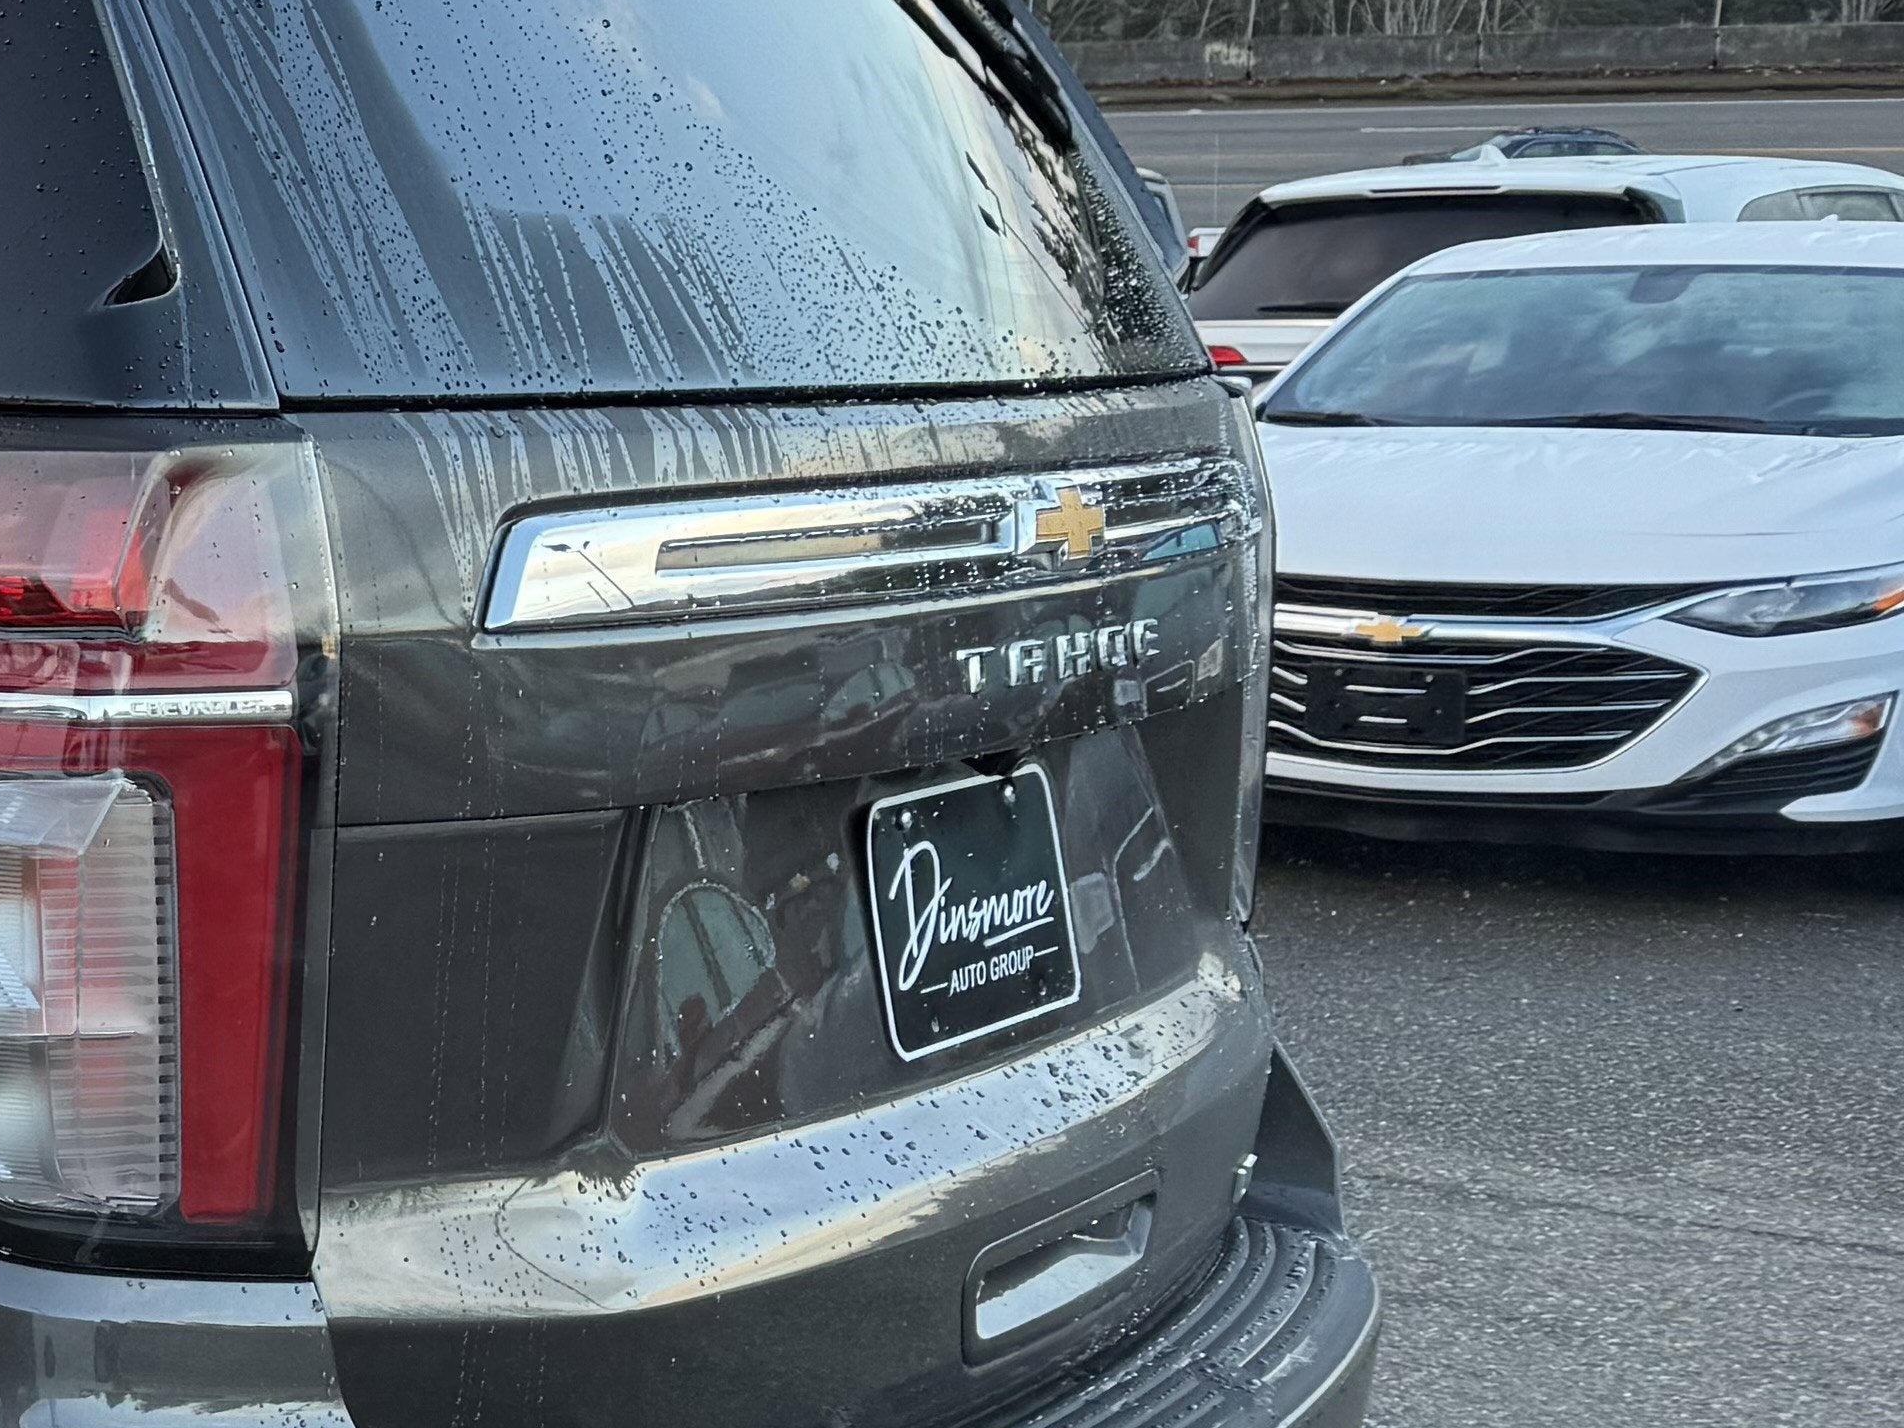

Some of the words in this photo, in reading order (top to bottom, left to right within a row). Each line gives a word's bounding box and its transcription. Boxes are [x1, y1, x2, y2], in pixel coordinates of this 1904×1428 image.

[955, 618, 1159, 694] TAHOE
[888, 840, 1054, 992] Dinsmore
[947, 961, 988, 997] AUTO
[989, 945, 1036, 983] GROUP
